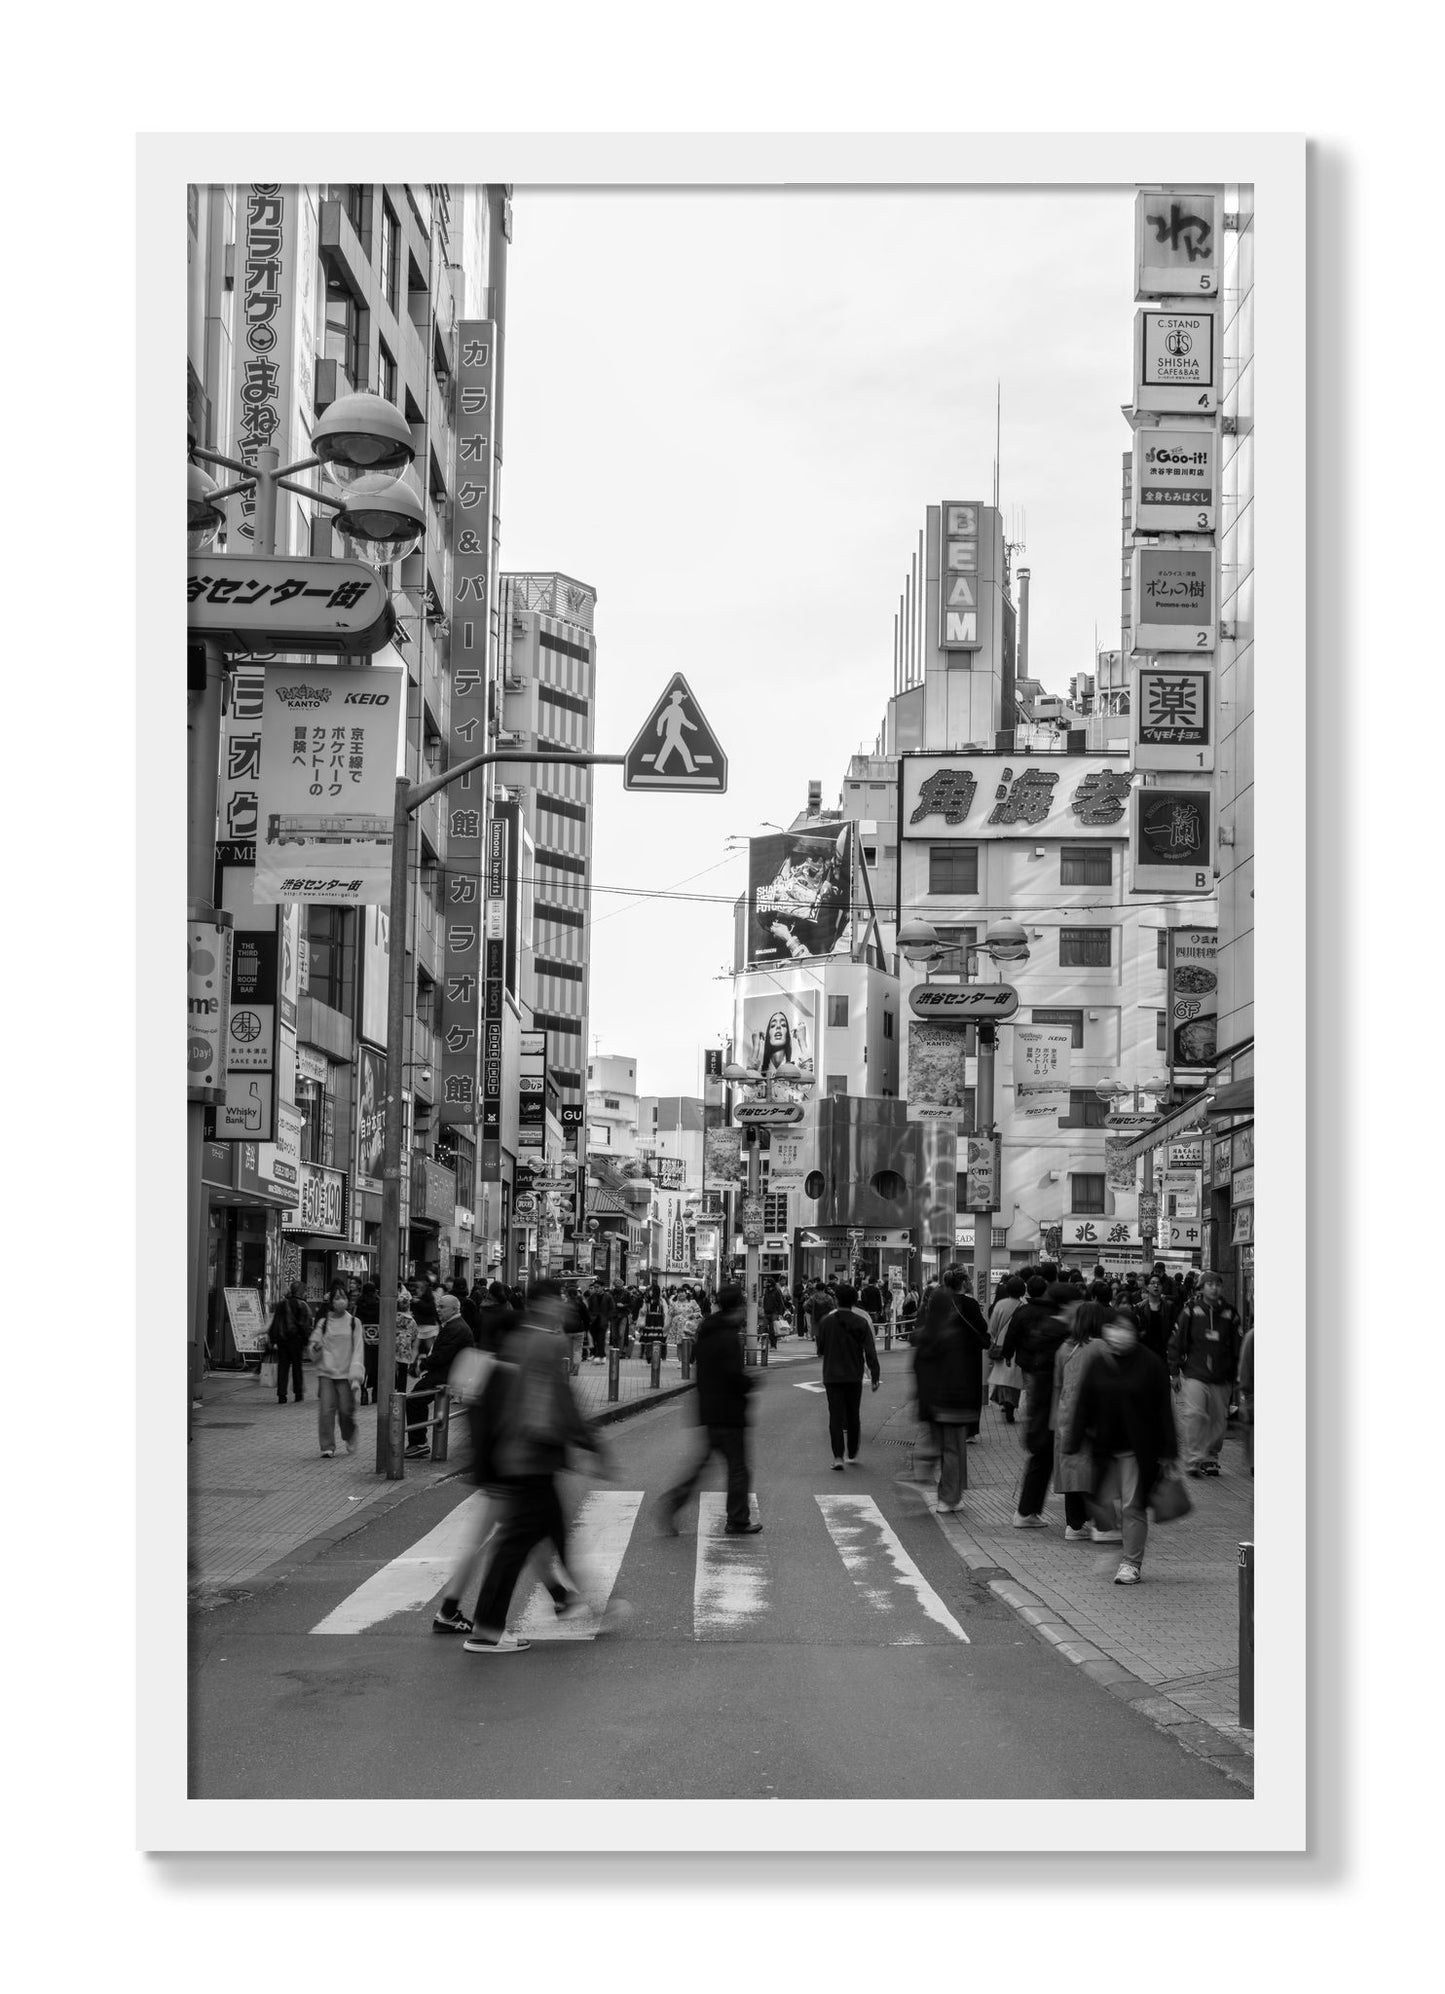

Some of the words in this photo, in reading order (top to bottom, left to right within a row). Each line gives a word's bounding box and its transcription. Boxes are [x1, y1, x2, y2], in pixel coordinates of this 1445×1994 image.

[244, 195, 283, 324] カラオケ
[1200, 275, 1211, 290] 5
[1158, 319, 1200, 329] C.STAND
[1158, 358, 1200, 368] SHISHA
[1157, 368, 1200, 376] CAFE&BAR
[1198, 393, 1210, 409] 4
[1156, 448, 1208, 465] Goo-it!
[1145, 490, 1209, 503] 全身もみほぐし
[1197, 512, 1208, 528] 3
[947, 506, 978, 642] BEAM
[1197, 632, 1208, 647] 2
[287, 700, 321, 708] KANTO
[344, 692, 390, 706] KEIO
[1149, 677, 1197, 726] 薬
[1143, 728, 1201, 741] マツモトキヨシ
[292, 726, 308, 767] 冒険へ
[308, 726, 326, 796] カントーの
[348, 727, 365, 783] 京王線で
[1196, 752, 1205, 767] 1
[910, 768, 1131, 825] 角海老
[493, 823, 502, 857] kimono
[280, 878, 364, 892] 渋谷センター街
[492, 861, 501, 894] hearts
[1195, 872, 1206, 887] B
[444, 879, 478, 1105] カラオケ館
[915, 992, 1012, 1005] 渋谷センター街
[1174, 1001, 1202, 1019] 6F
[226, 1107, 257, 1118] Whisky
[563, 1110, 582, 1121] GU
[737, 1107, 796, 1116] 渋谷センター街
[225, 1116, 245, 1124] Bank
[674, 1221, 683, 1260] BEER
